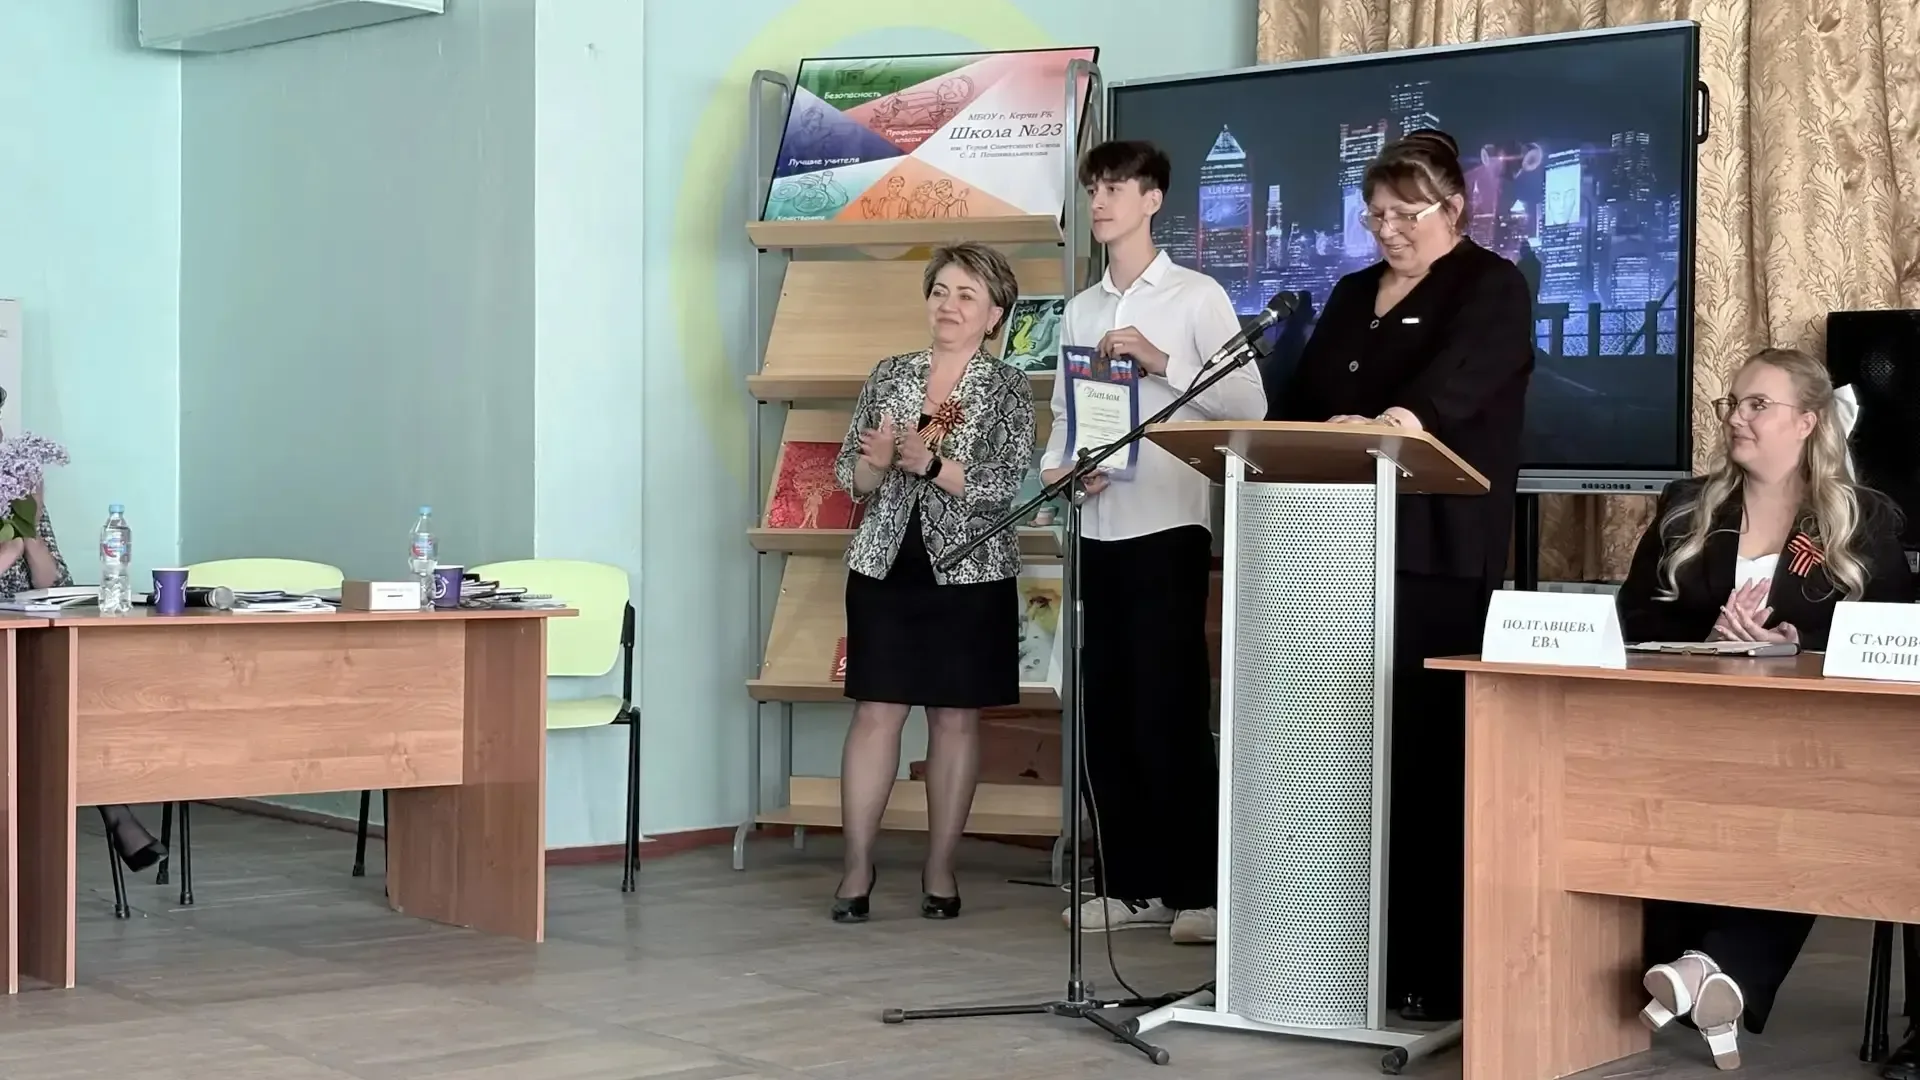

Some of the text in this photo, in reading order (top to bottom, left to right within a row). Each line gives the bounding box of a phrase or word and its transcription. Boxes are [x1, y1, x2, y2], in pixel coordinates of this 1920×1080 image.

[824, 91, 882, 100] Безопасность
[967, 112, 998, 120] МБОУ
[1009, 112, 1038, 121] Керчи
[885, 129, 935, 138] Профильные
[948, 123, 1063, 139] Школа №23
[788, 157, 861, 167] Лучшие учителя
[1084, 386, 1120, 401] Диплом
[1502, 619, 1595, 633] ПОЛТАВЦЕВА
[1531, 635, 1560, 648] ЕВА
[1849, 632, 1920, 647] СТАРОВ
